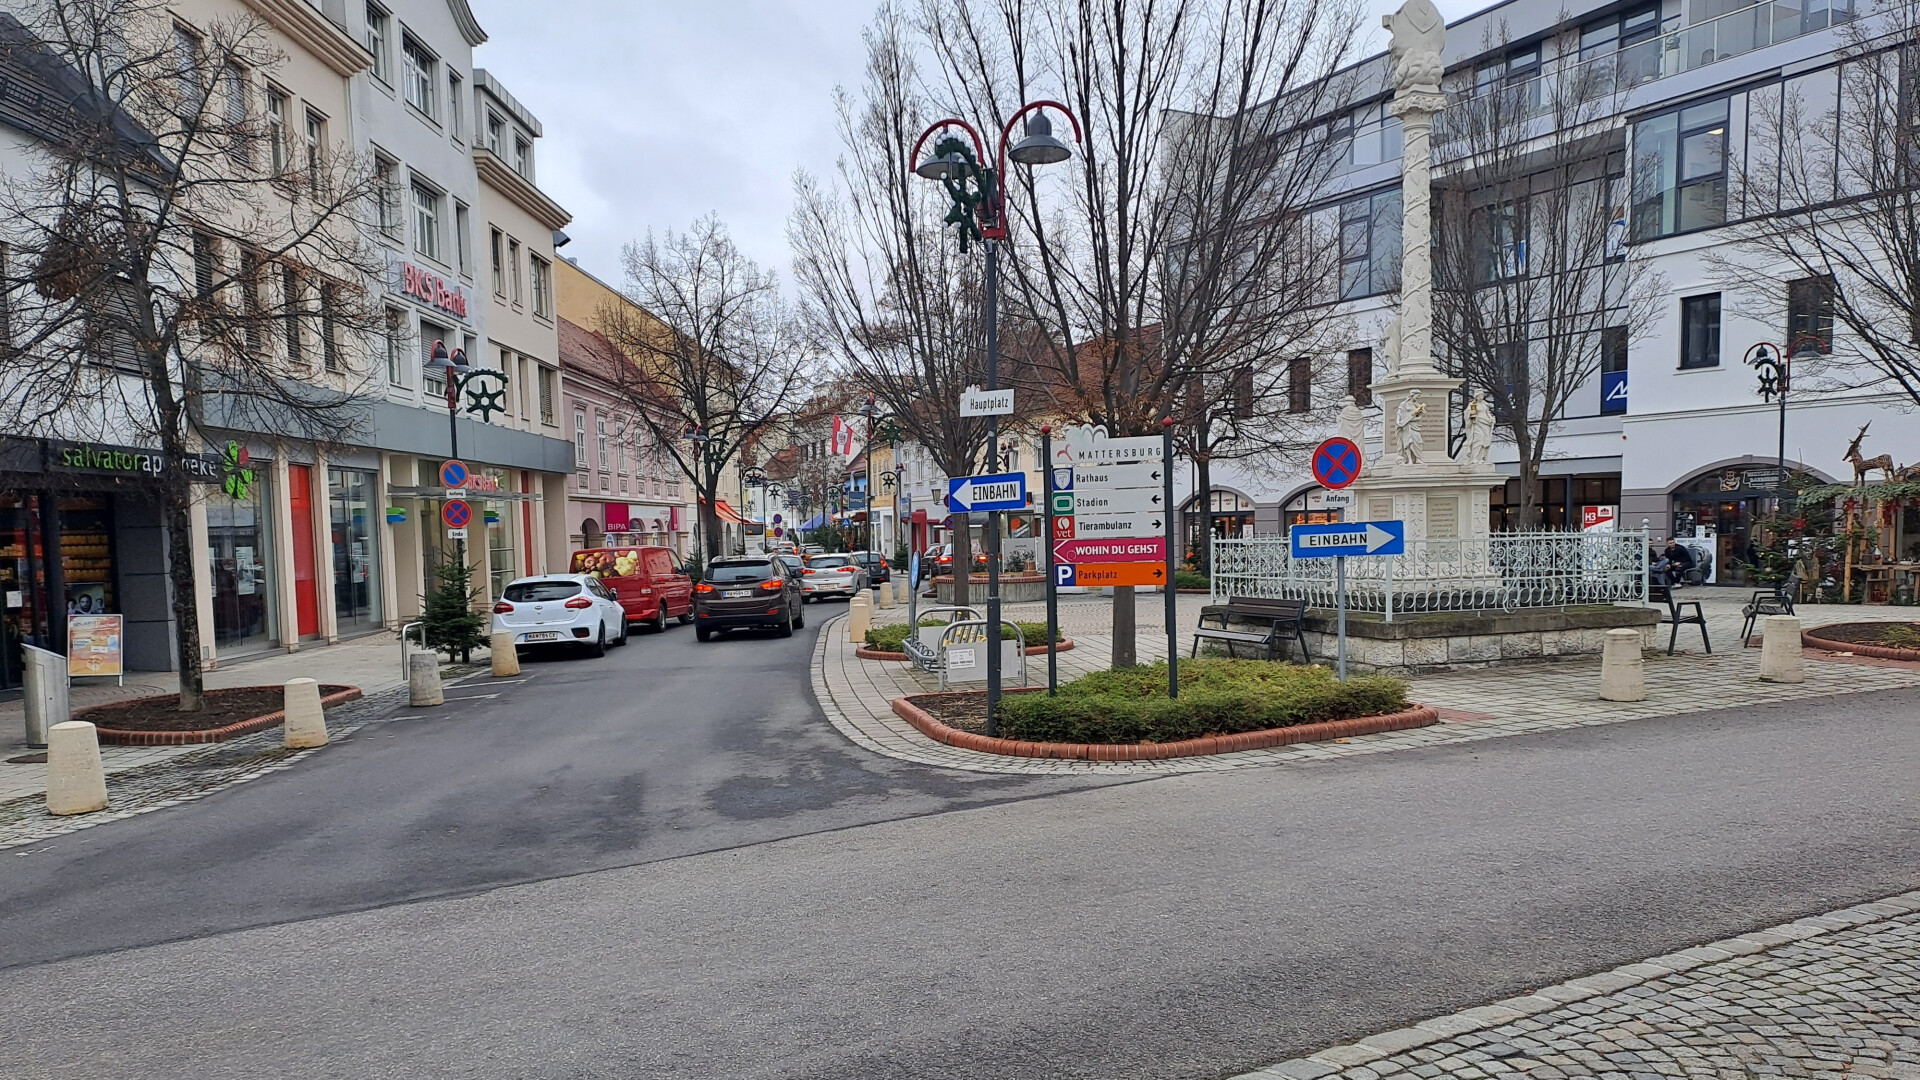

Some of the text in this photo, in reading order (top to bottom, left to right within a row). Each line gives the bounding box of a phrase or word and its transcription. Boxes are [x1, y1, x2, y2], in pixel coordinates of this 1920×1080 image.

[404, 262, 467, 318] BKS Bank
[970, 396, 1008, 412] Hauptplatz
[1079, 447, 1161, 460] MATTERSBURG
[1076, 474, 1109, 483] Rathaus
[972, 483, 1017, 501] EINBAHN
[1077, 498, 1108, 507] Stadion
[1326, 494, 1350, 503] Anfang
[607, 523, 627, 531] BIPA
[1079, 521, 1132, 531] Tierambulanz
[1309, 533, 1368, 546] EINBAHN
[1075, 544, 1158, 555] WOHIN DU GEHST
[1057, 565, 1073, 585] P
[1078, 570, 1118, 580] Parkplatz
